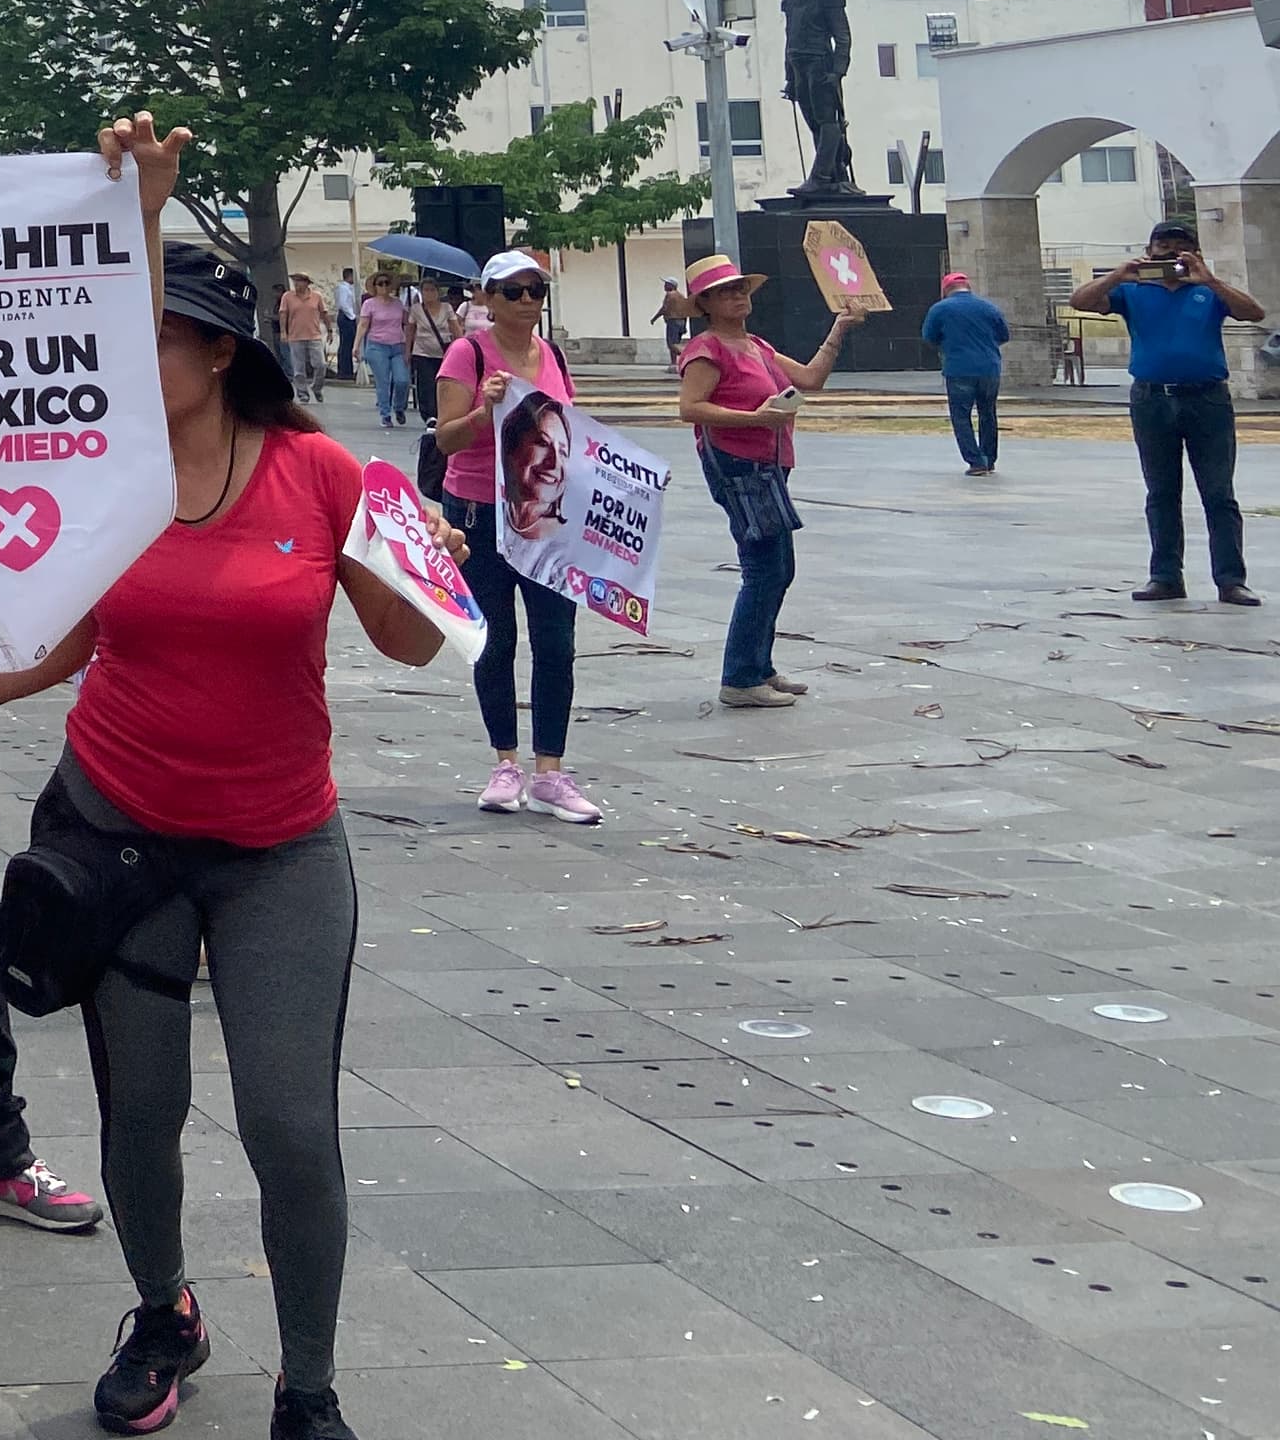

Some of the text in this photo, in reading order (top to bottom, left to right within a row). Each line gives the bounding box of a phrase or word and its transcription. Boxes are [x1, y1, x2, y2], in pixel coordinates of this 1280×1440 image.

[25, 334, 99, 376] UN
[584, 435, 666, 491] XÓCHITL
[584, 510, 644, 554] MÉXICO
[591, 488, 625, 521] POR
[626, 510, 648, 533] UN
[369, 487, 456, 589] XÓCHITL
[582, 528, 640, 567] SIN MIEDO
